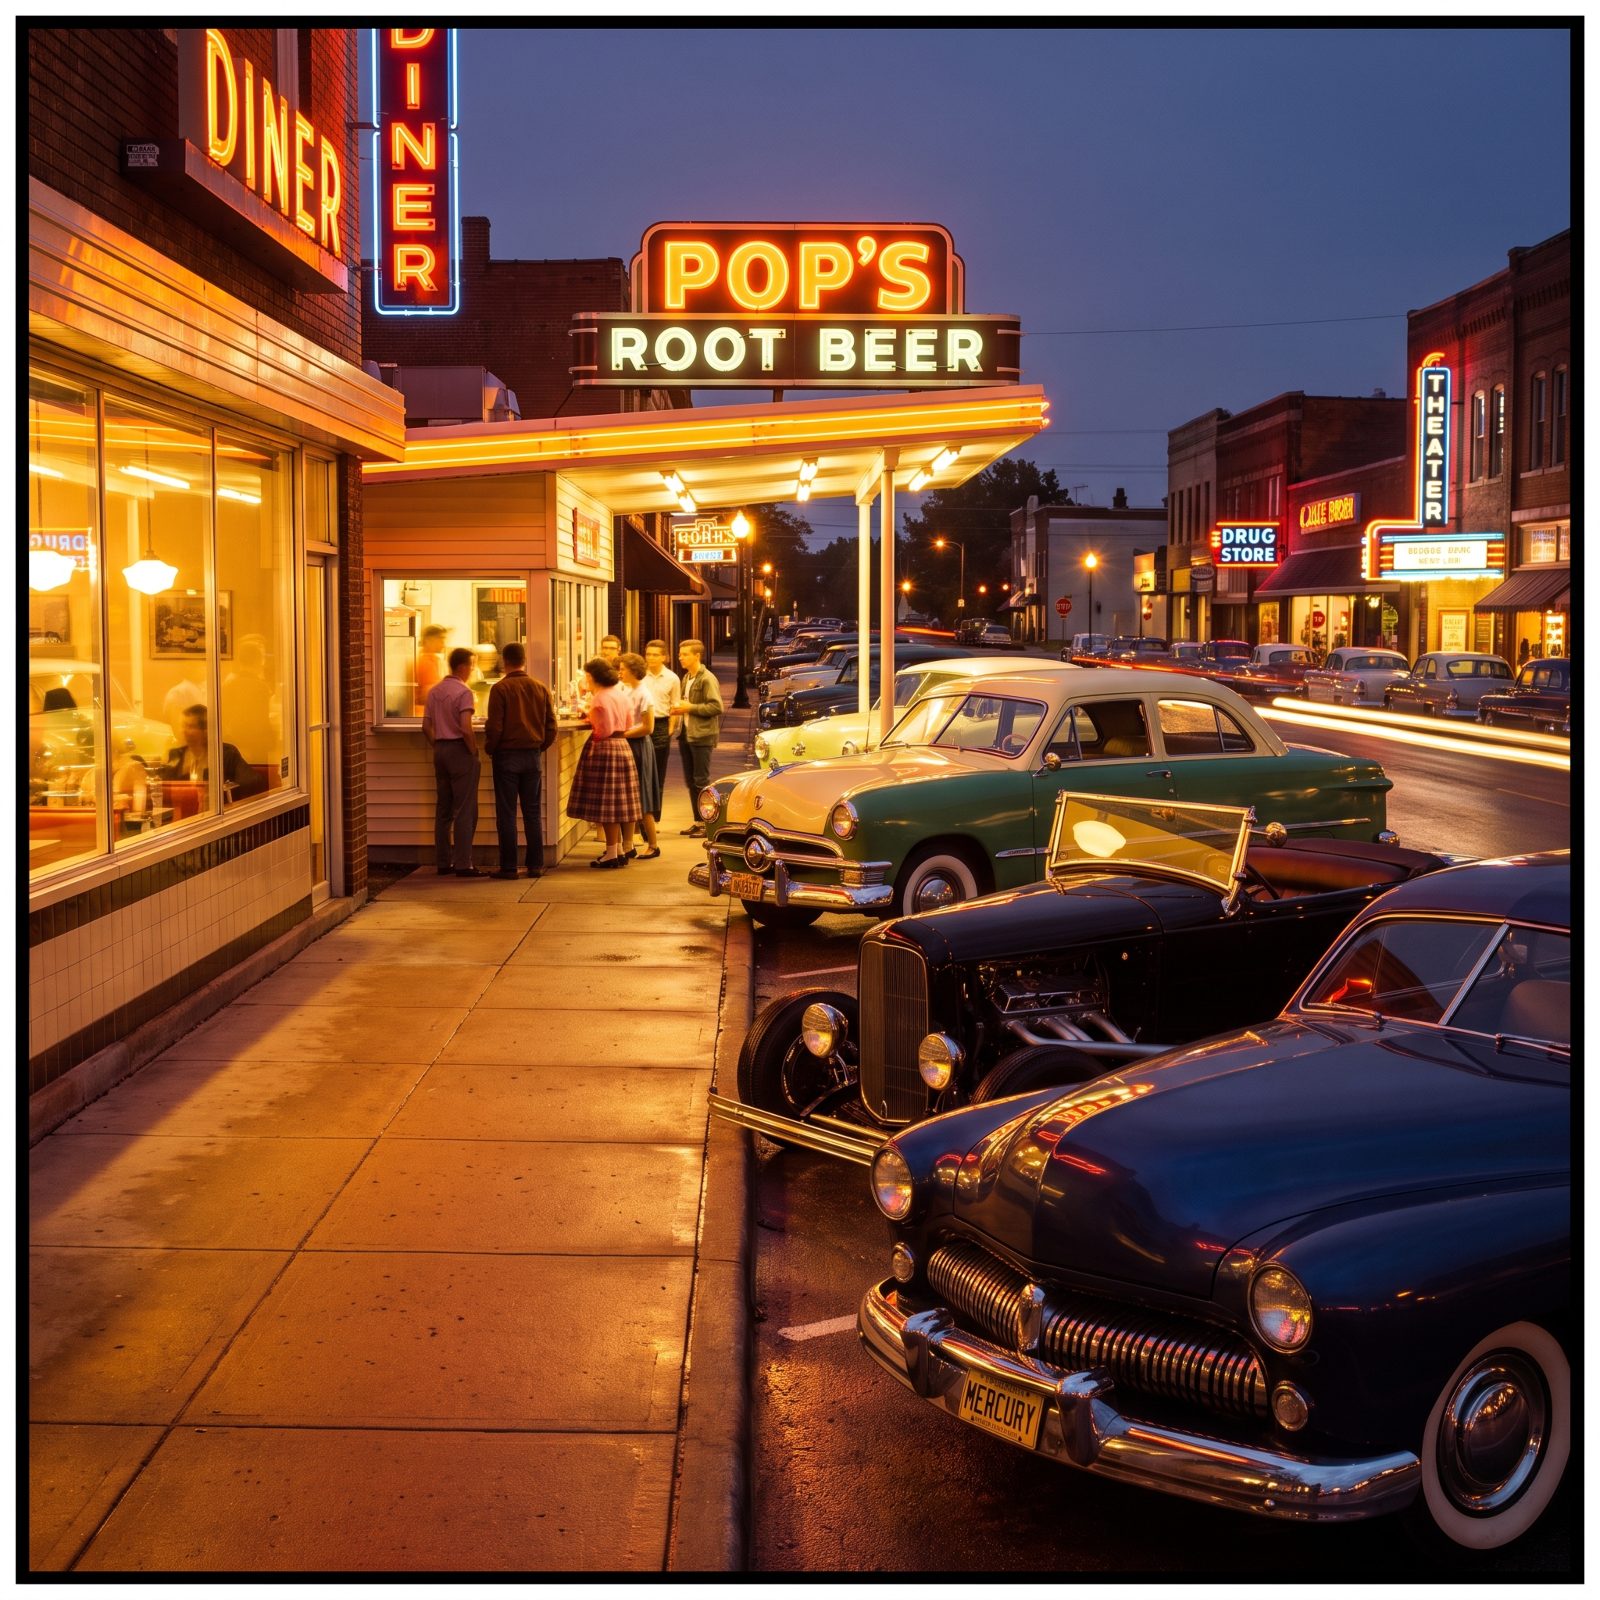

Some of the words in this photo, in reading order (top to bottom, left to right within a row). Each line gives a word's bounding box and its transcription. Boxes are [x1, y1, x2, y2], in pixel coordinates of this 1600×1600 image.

[206, 28, 341, 258] DINER
[664, 236, 932, 312] POP'S
[611, 326, 787, 373] ROOT
[819, 327, 985, 373] BEER
[1425, 374, 1445, 520] THEATER
[1221, 528, 1276, 544] DRUG
[1221, 547, 1275, 562] STORE
[963, 1380, 1037, 1435] MERCURY
